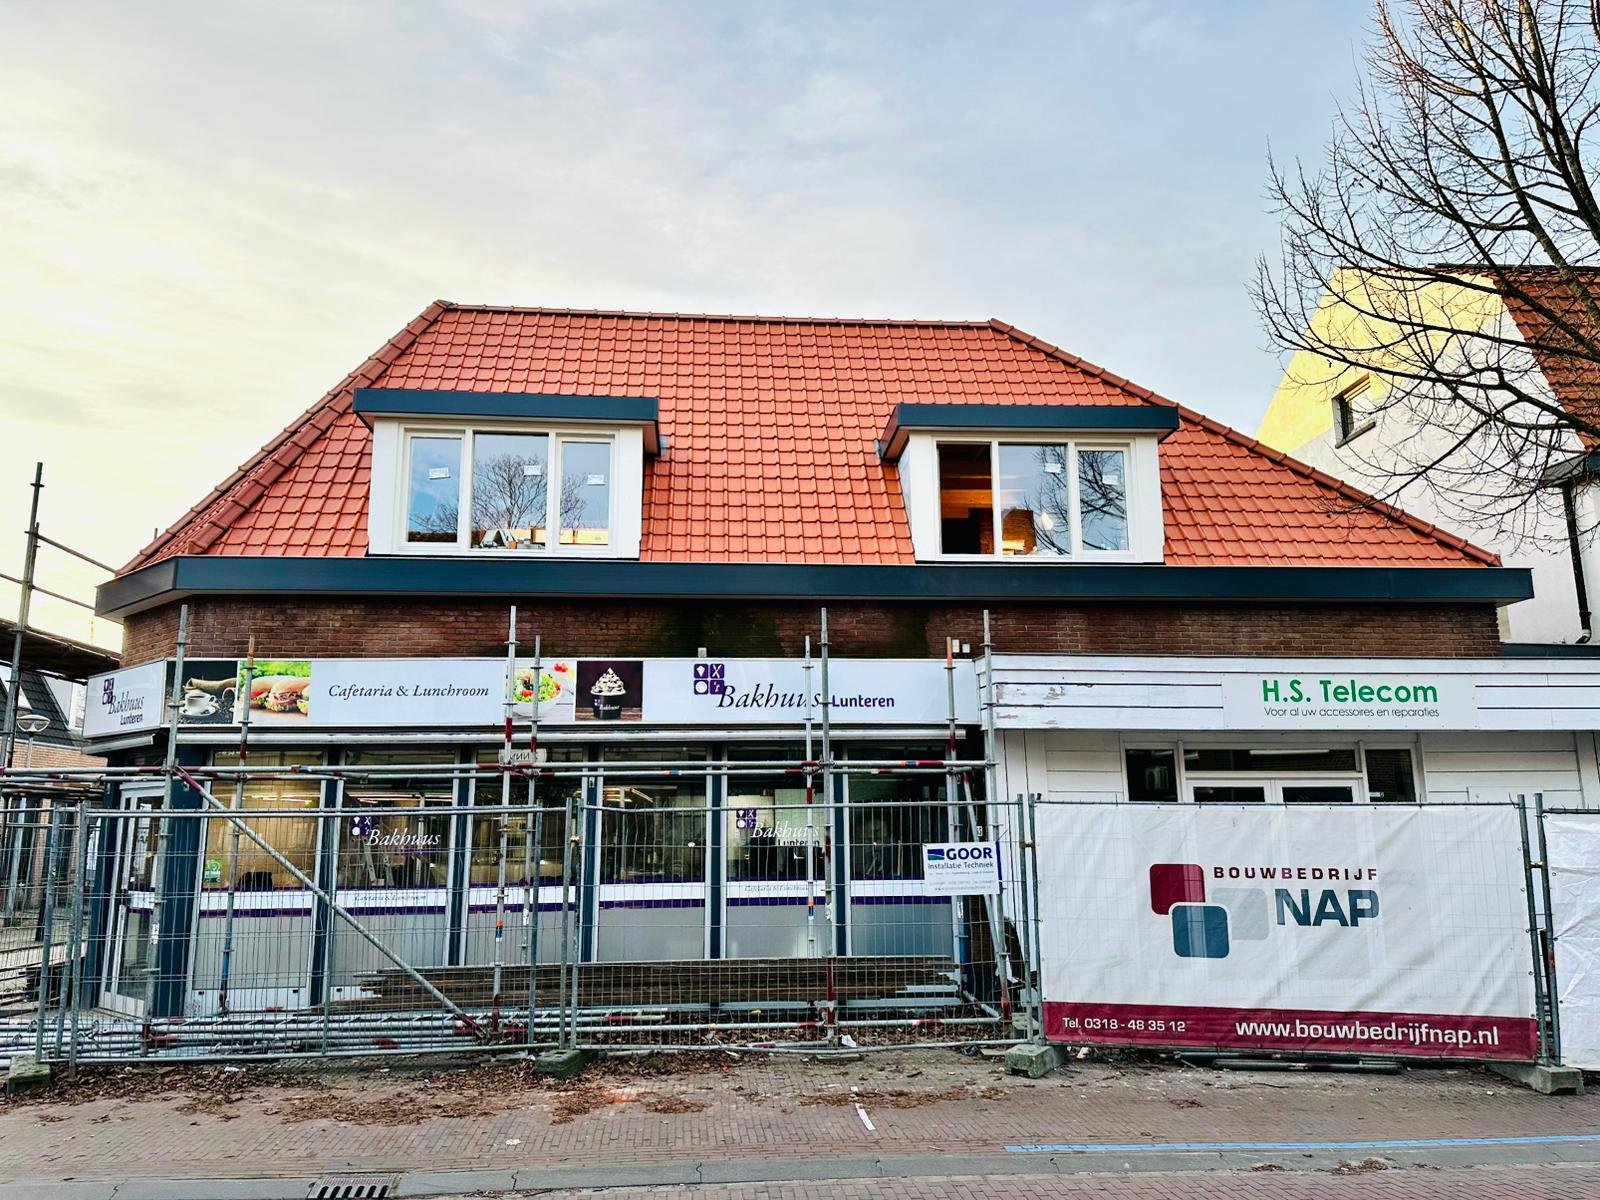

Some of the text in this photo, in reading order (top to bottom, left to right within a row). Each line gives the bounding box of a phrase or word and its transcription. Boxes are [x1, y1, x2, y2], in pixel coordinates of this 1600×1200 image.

[328, 684, 489, 700] Cafetaria & Lunchroom
[1262, 679, 1438, 703] H.S. Telecom
[832, 694, 895, 707] Lunteren
[1264, 707, 1287, 716] Voor
[1290, 707, 1299, 716] al
[1319, 707, 1374, 717] accessoires
[1377, 708, 1389, 716] en
[1392, 707, 1440, 718] reparaties
[946, 847, 993, 861] GOOR
[928, 860, 994, 870] Installatie Techniek
[1213, 866, 1377, 881] BOUWBEDRIJF
[1274, 888, 1380, 927] NAP
[1062, 1017, 1081, 1028] Tel.
[1084, 1018, 1118, 1029] 0318
[1127, 1020, 1145, 1030] 48
[1148, 1020, 1165, 1031] 35
[1169, 1021, 1186, 1032] 12
[1235, 1019, 1499, 1047] www.bouwbedrijfnap.nl
